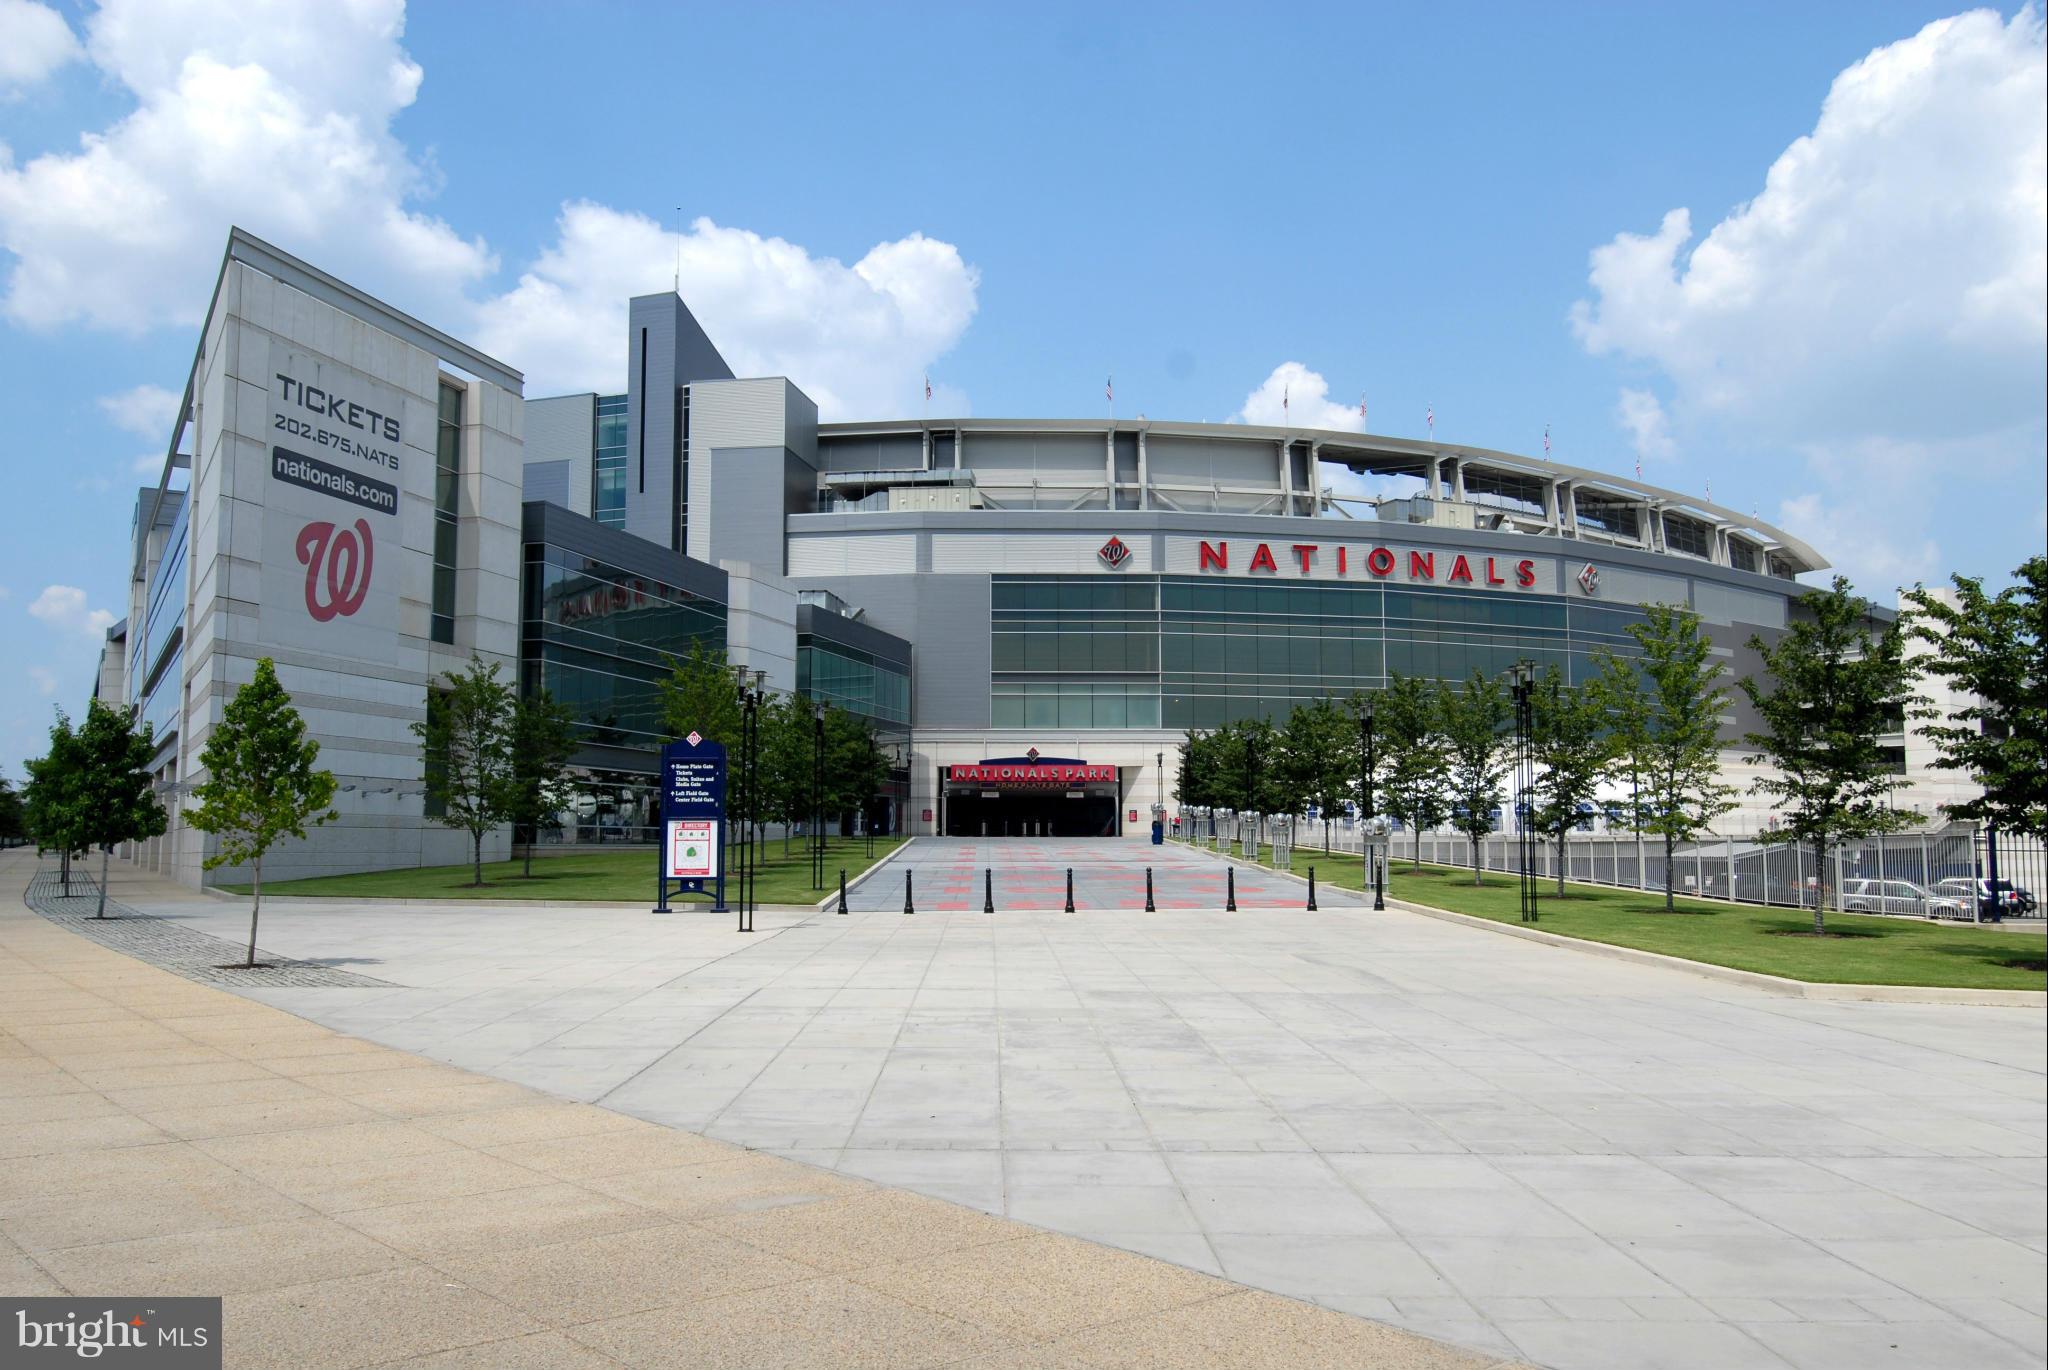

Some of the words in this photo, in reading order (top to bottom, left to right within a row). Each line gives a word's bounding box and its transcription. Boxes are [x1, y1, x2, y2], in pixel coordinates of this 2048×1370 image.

[276, 373, 400, 442] TICKETS
[275, 413, 399, 470] 202.675.NATS
[277, 456, 394, 508] nationals.com
[1199, 540, 1537, 588] NATIONALS
[955, 768, 1059, 779] NATIONALS
[1065, 768, 1110, 779] PARK
